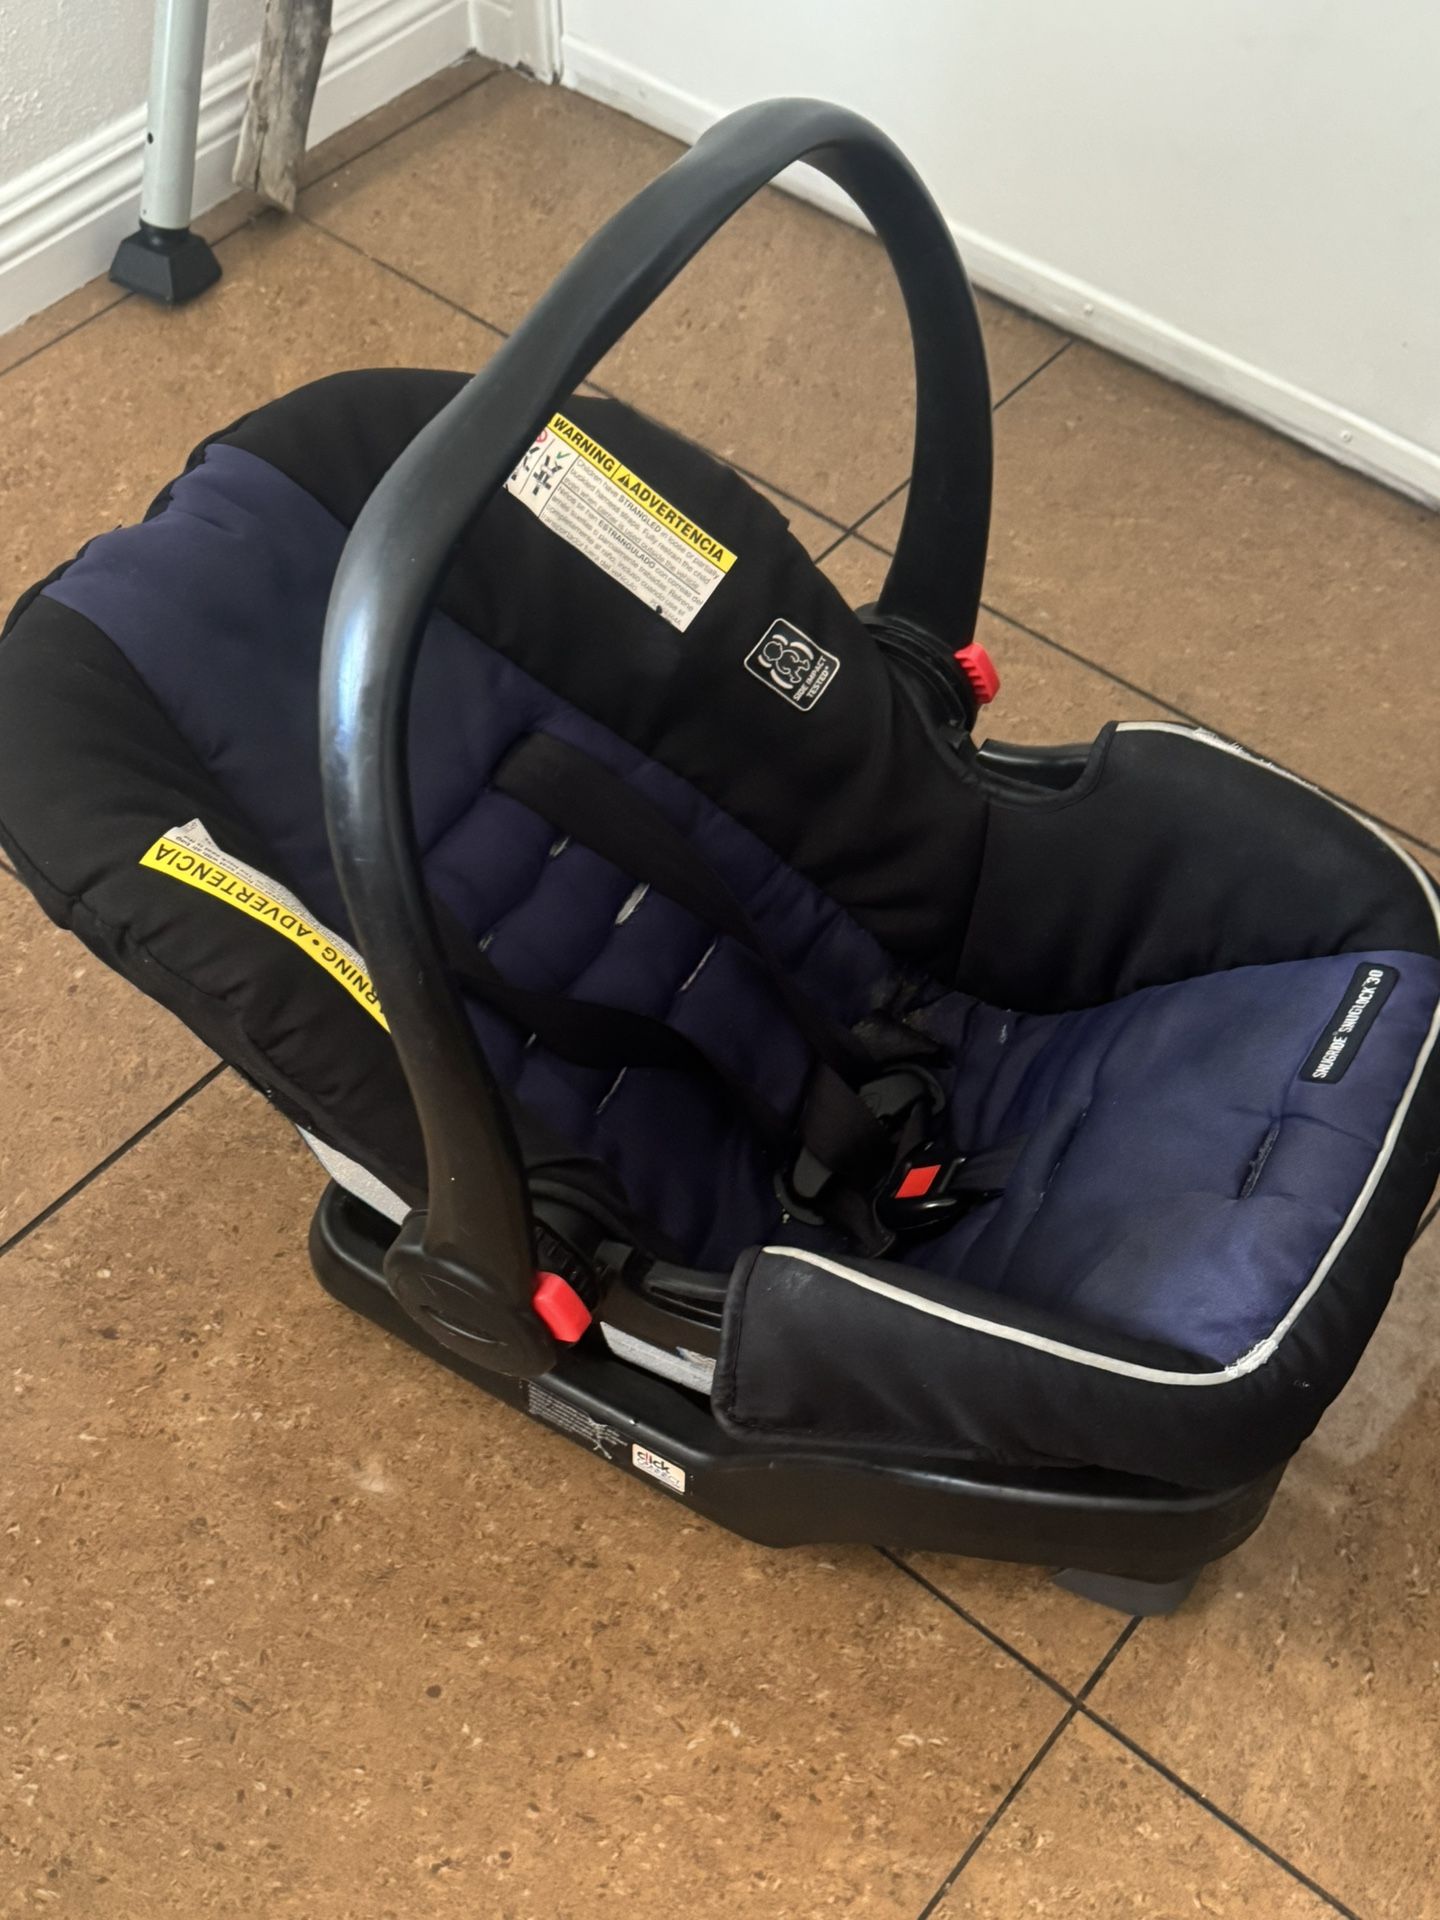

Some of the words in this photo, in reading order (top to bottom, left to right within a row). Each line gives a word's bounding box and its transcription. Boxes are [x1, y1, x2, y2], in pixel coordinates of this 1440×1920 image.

[552, 416, 615, 473] WARNING
[616, 493, 662, 534] STRANGLED
[629, 481, 725, 563] ADVERTENCIA
[597, 519, 656, 570] ESTRANGULADO
[793, 685, 809, 702] SIDE
[807, 655, 827, 686] IMPACT
[154, 843, 313, 938] ADVERTENCIA
[321, 946, 380, 1006] RNING
[1366, 969, 1384, 986] 30
